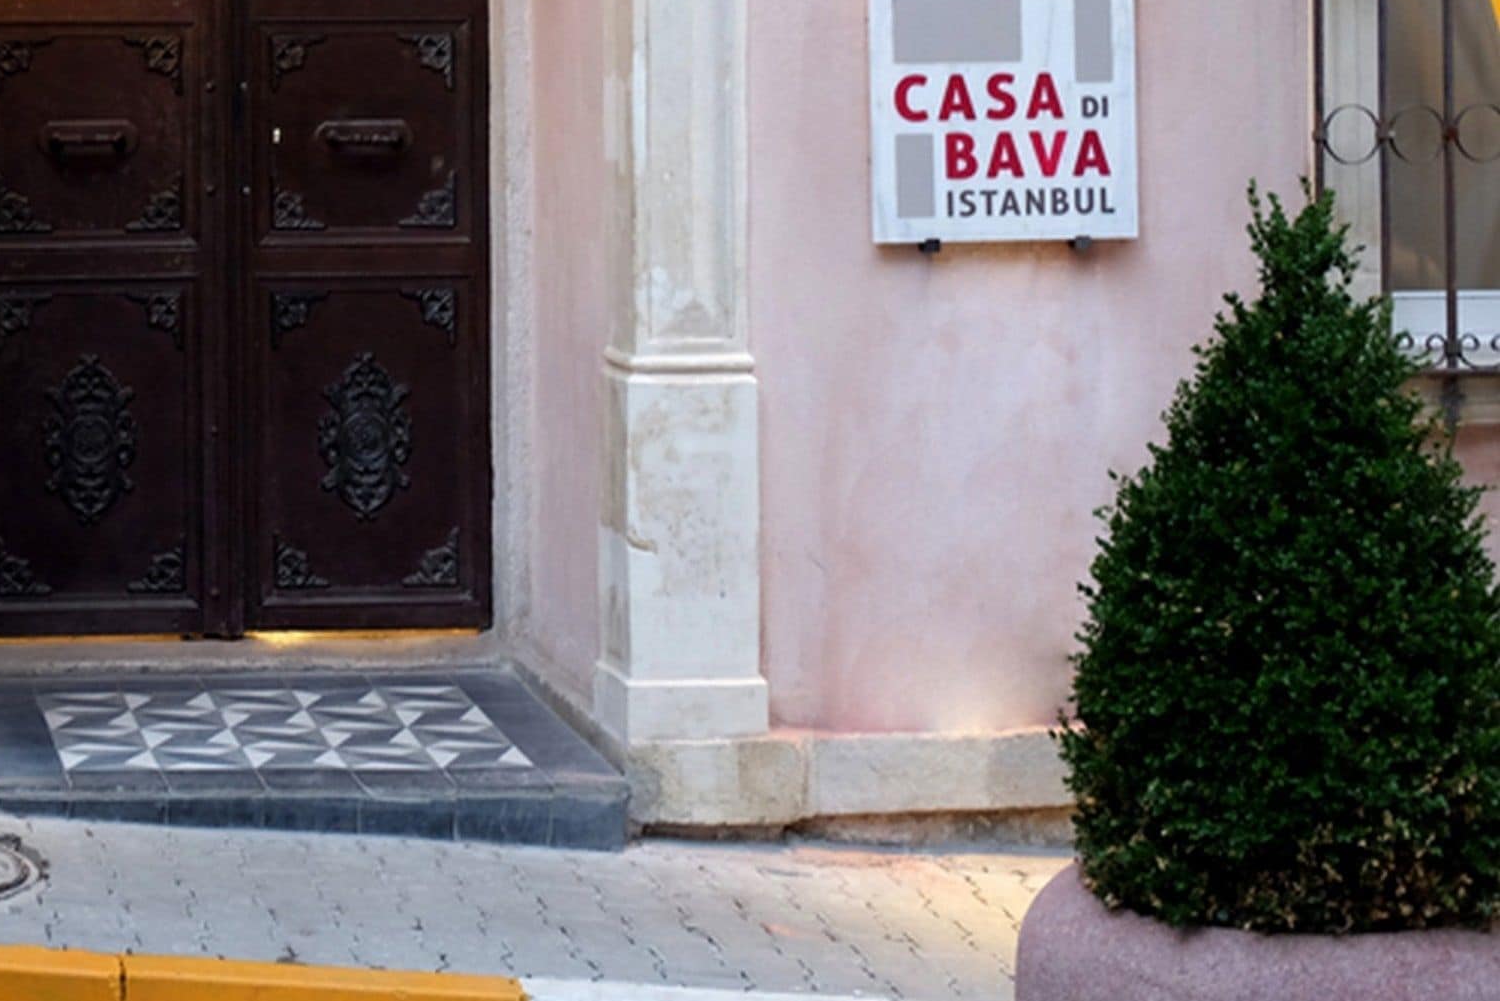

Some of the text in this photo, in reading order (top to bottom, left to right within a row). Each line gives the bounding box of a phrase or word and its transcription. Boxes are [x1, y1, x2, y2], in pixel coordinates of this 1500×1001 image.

[893, 72, 1109, 122] CASA DI
[945, 129, 1111, 180] BAVA
[946, 187, 1115, 218] ISTANBUL
